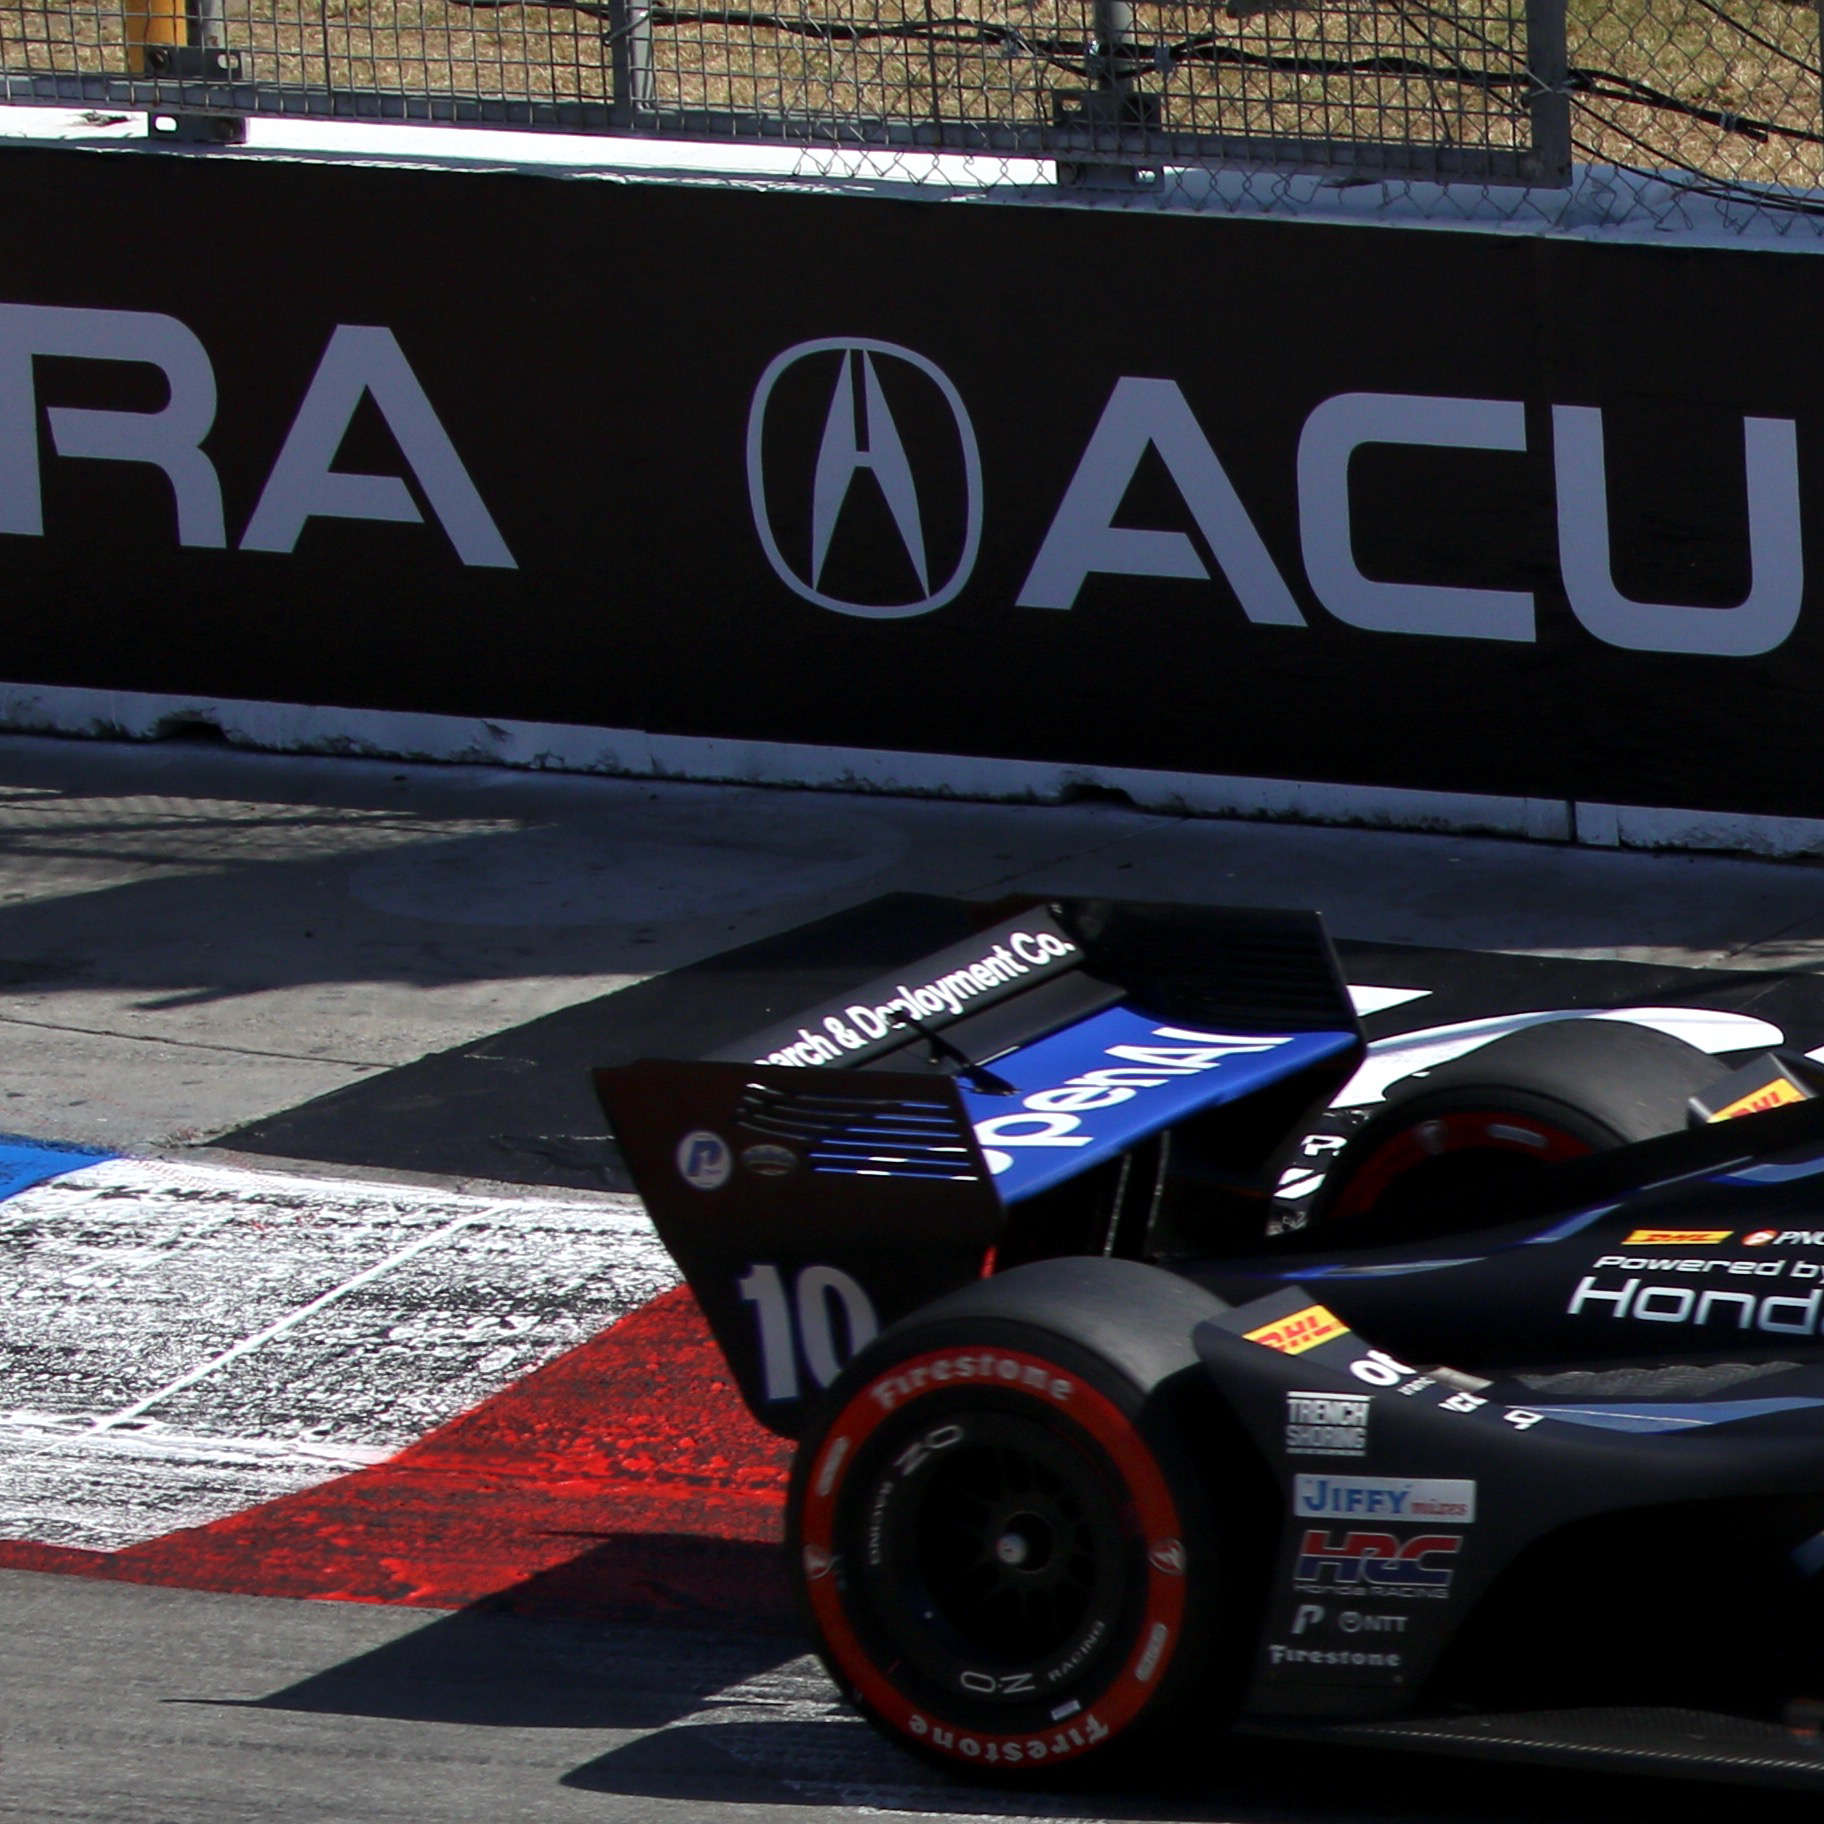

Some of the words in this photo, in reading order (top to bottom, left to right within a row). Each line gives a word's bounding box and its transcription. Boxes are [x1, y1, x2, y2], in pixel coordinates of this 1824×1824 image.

[823, 1016, 868, 1050] &
[1009, 931, 1077, 966] Co.
[974, 1027, 1296, 1175] penAI
[1593, 1255, 1787, 1277] Powered
[738, 1263, 881, 1400] 10
[868, 1353, 1076, 1410] Firestone
[1302, 1479, 1411, 1515] JIFFY
[1293, 1529, 1463, 1588] HRC
[1364, 1616, 1408, 1633] NTT
[1268, 1643, 1401, 1667] Firestone
[907, 1711, 1110, 1767] Firestone
